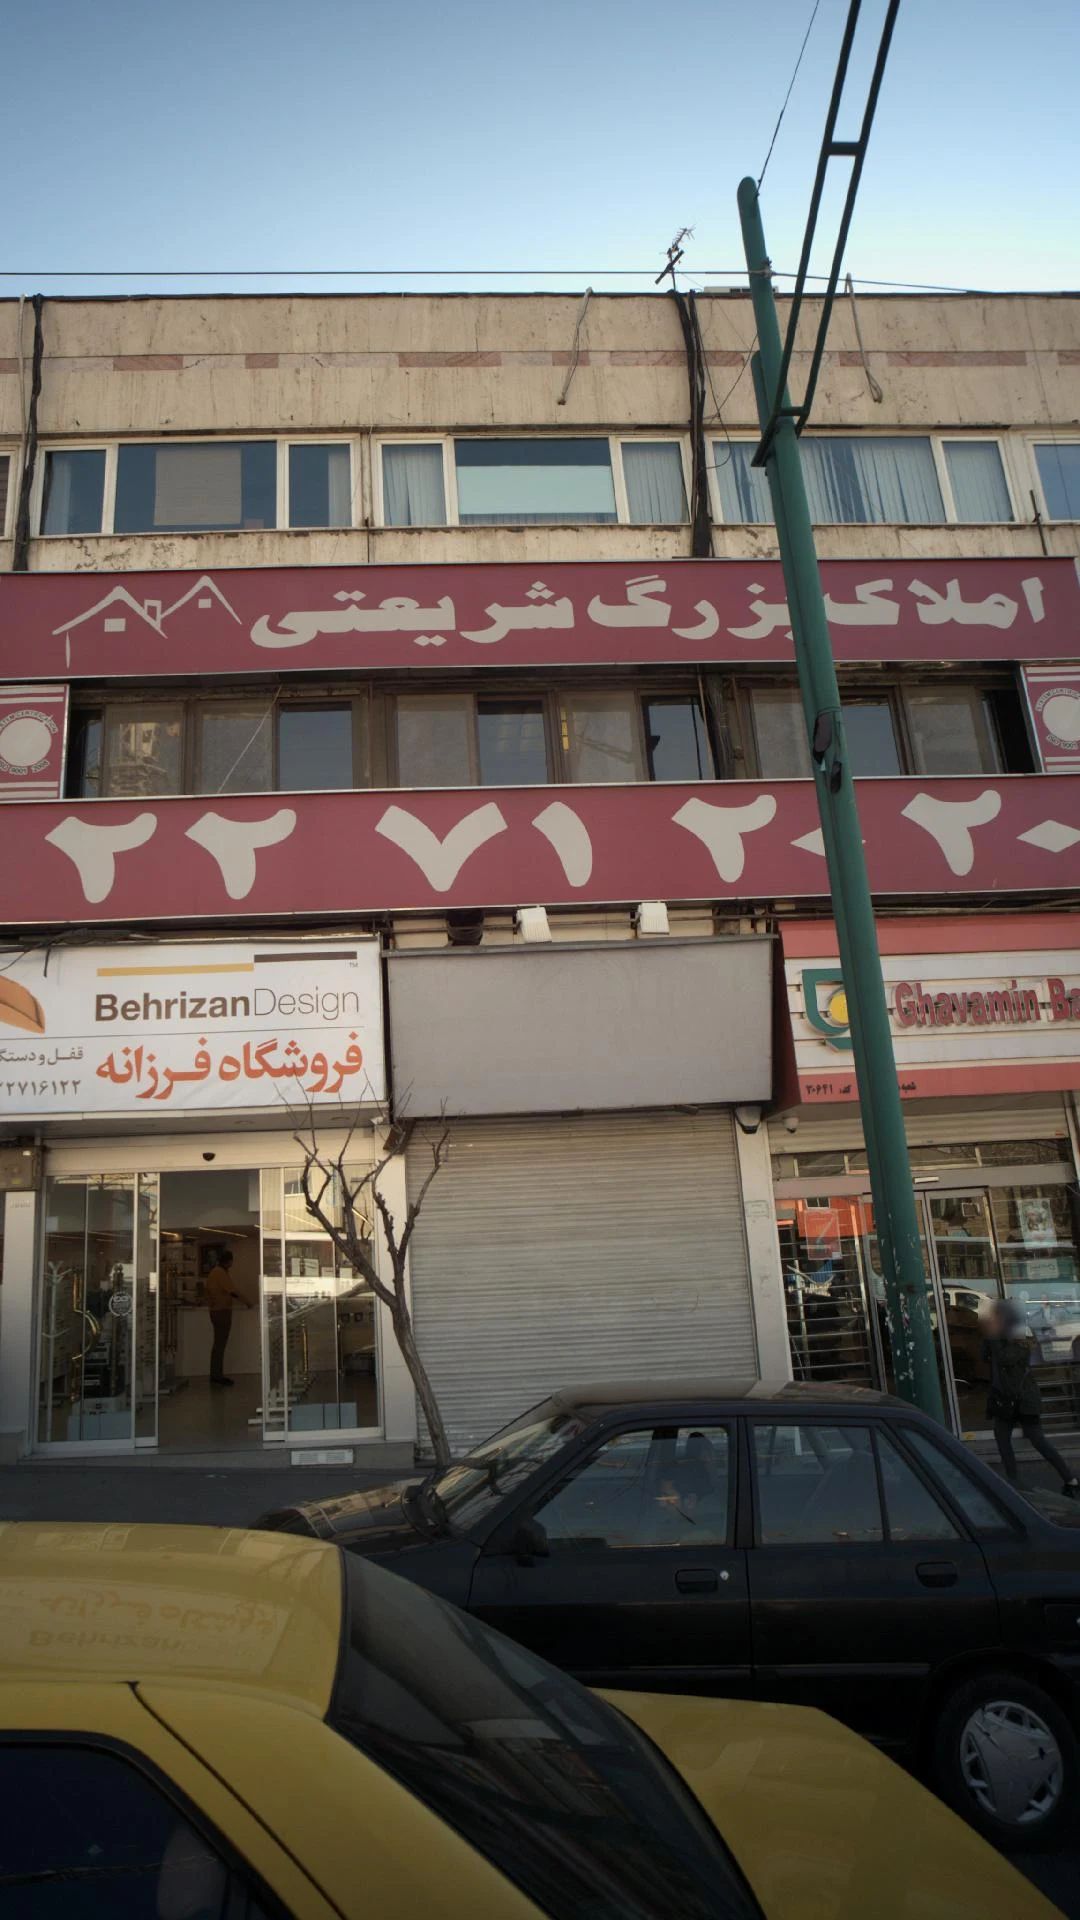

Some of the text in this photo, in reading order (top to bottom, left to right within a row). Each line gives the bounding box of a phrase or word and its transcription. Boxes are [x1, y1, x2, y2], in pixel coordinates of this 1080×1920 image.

[250, 574, 1044, 649] املاک زرگ شریعتی
[894, 979, 1041, 1028] Ghavamin
[47, 1046, 83, 1066] قفل
[96, 1031, 363, 1100] فروشگاه فرزانه
